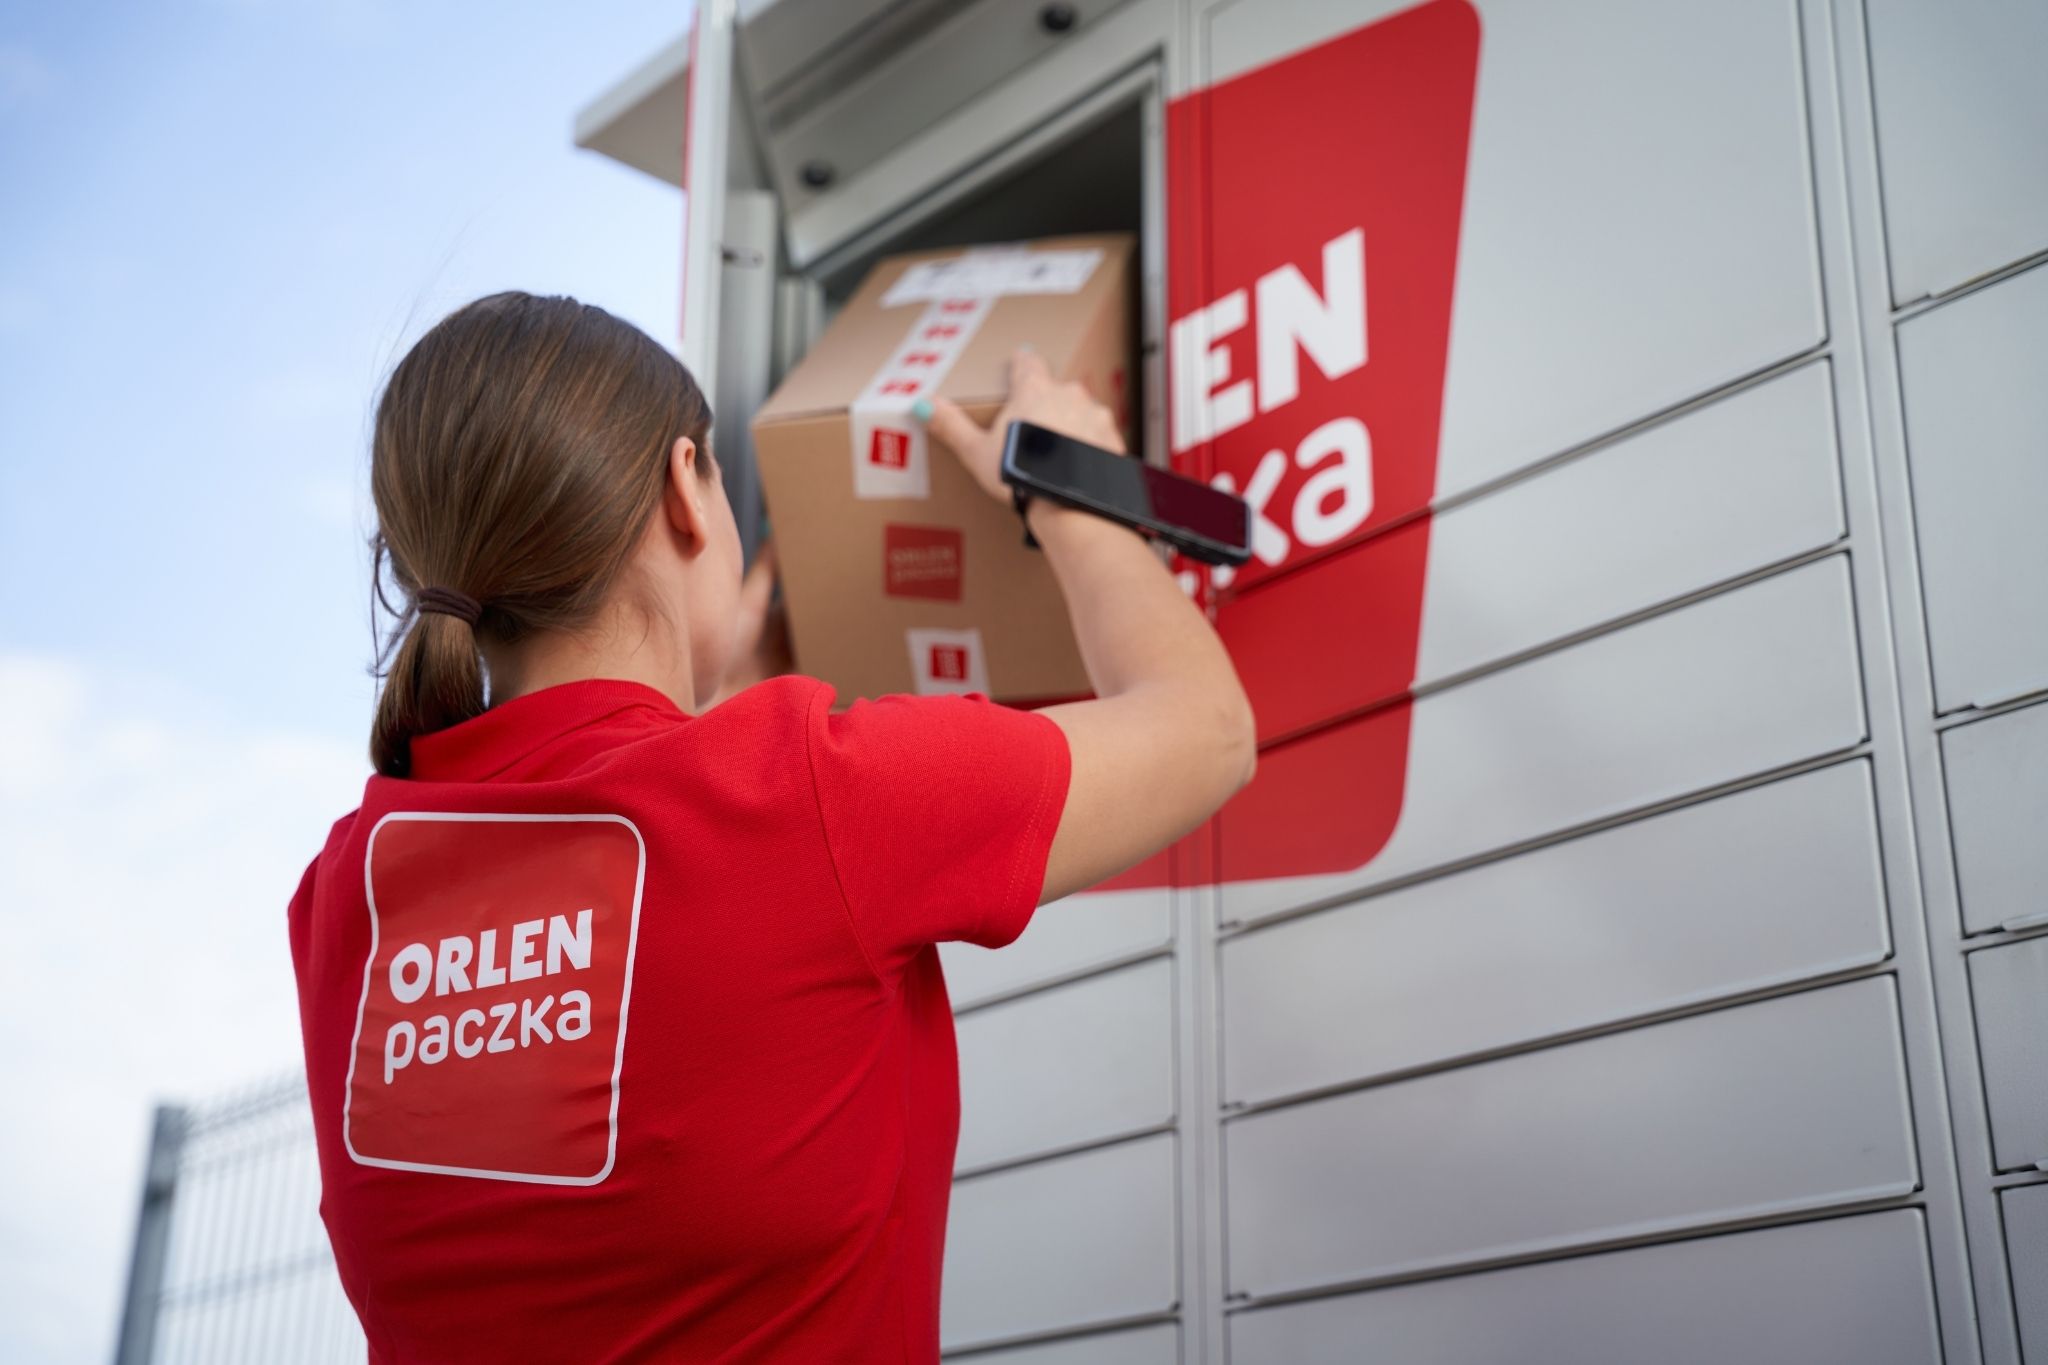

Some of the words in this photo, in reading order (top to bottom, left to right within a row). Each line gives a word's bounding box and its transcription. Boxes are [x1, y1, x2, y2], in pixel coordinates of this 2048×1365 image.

[1177, 416, 1374, 600] ka
[389, 908, 593, 1004] ORLEN
[384, 989, 592, 1085] paczka
